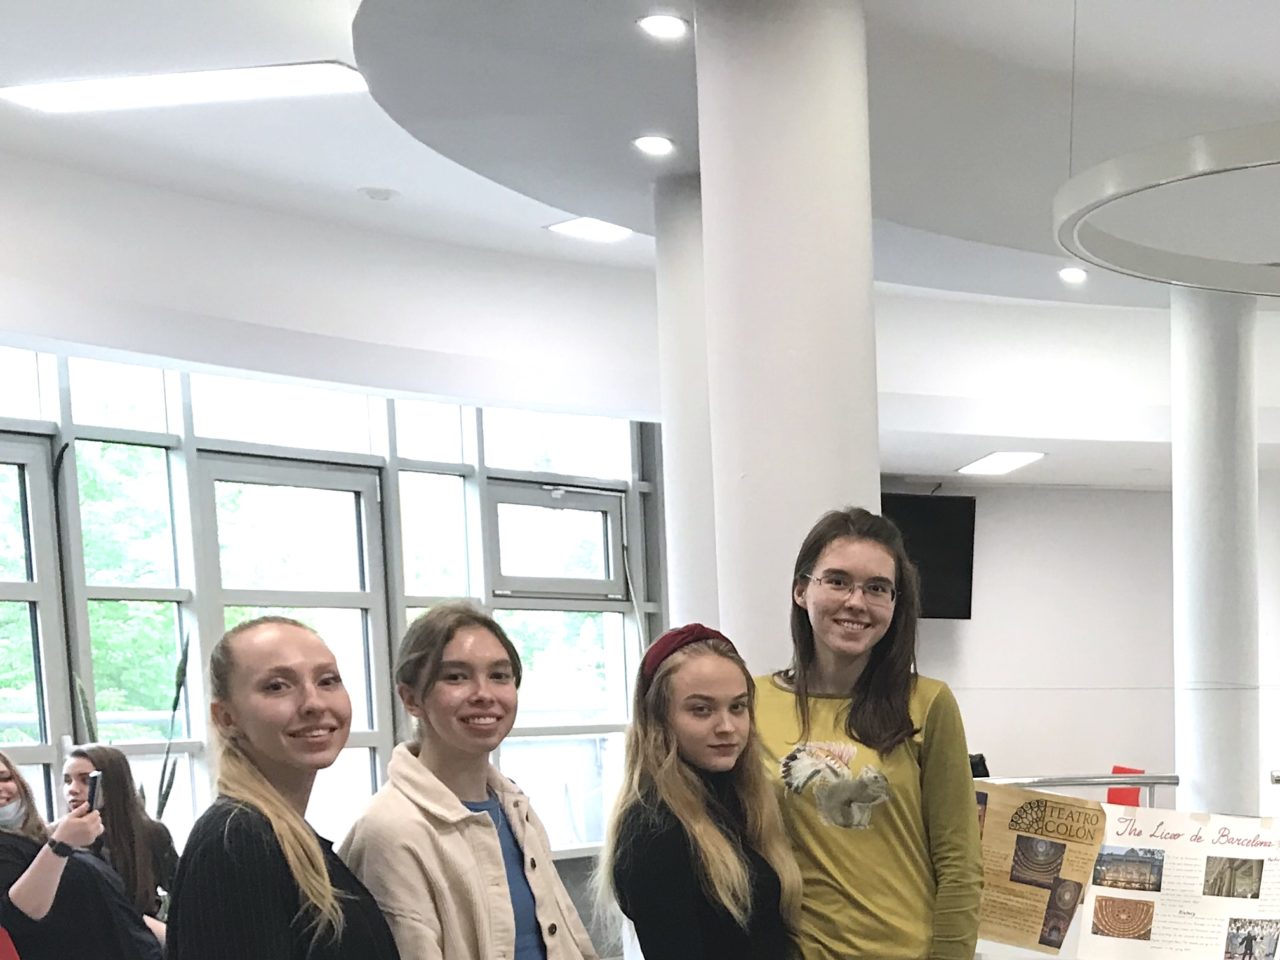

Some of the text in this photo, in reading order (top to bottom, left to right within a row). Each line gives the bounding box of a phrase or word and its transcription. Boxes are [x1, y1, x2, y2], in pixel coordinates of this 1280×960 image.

[1046, 805, 1100, 826] TEATRO
[1116, 816, 1143, 837] The
[1189, 827, 1205, 843] de
[1211, 826, 1275, 848] Barcelona
